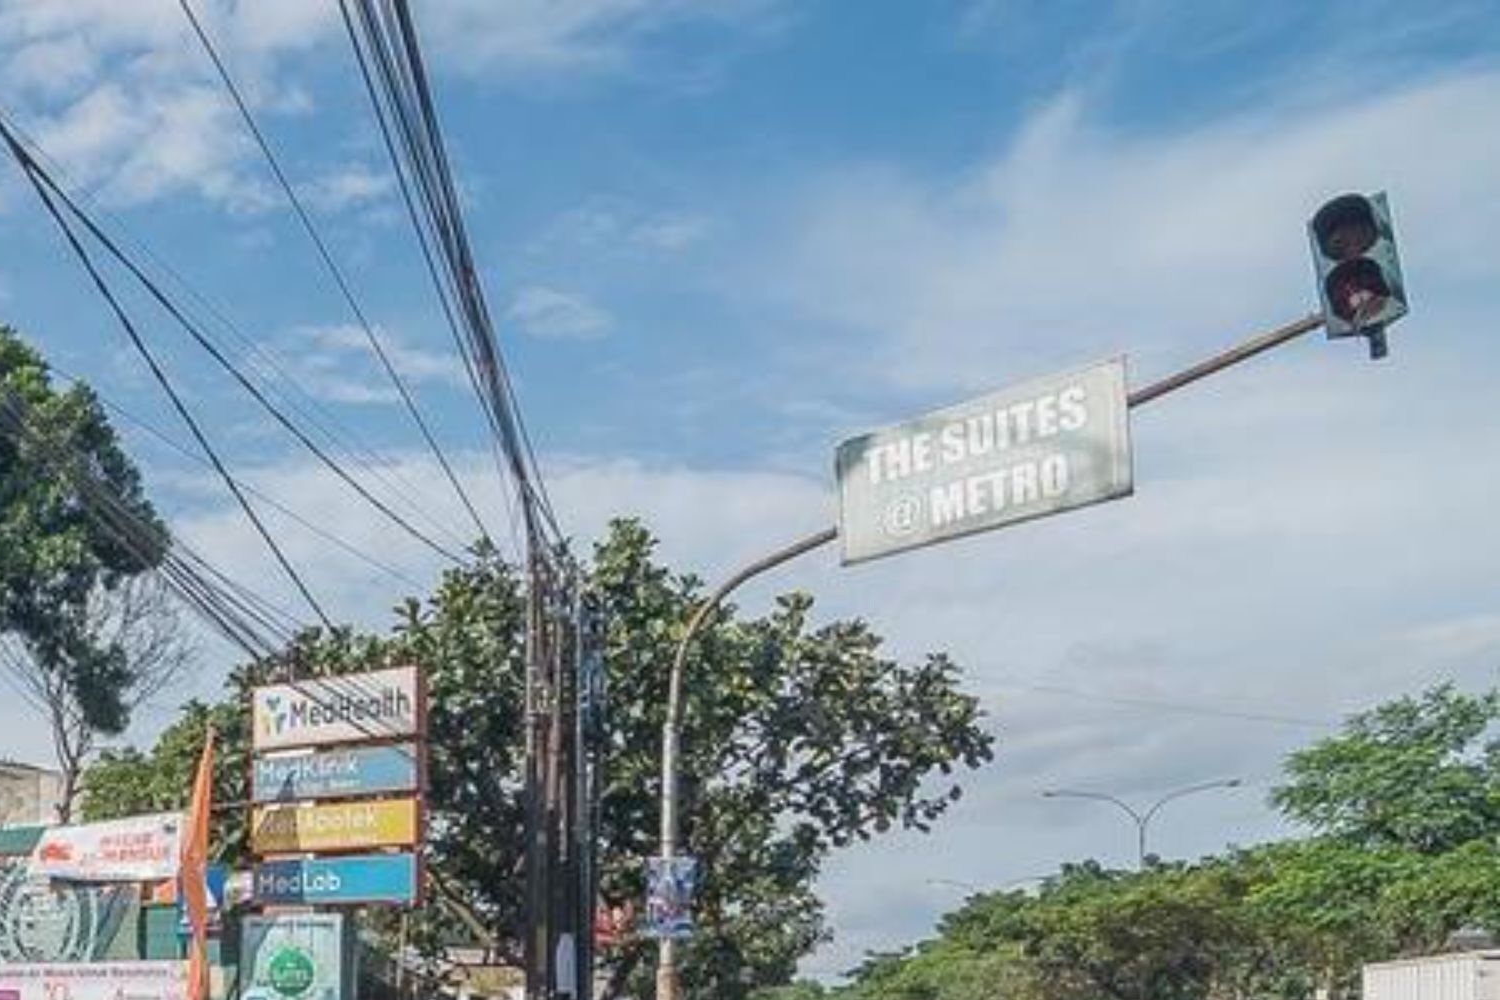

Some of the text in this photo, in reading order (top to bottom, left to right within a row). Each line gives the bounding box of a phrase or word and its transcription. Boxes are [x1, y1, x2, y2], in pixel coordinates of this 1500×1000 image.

[864, 386, 1087, 484] THE SUITES
[290, 687, 410, 727] MedHealth
[259, 870, 341, 894] MedLab
